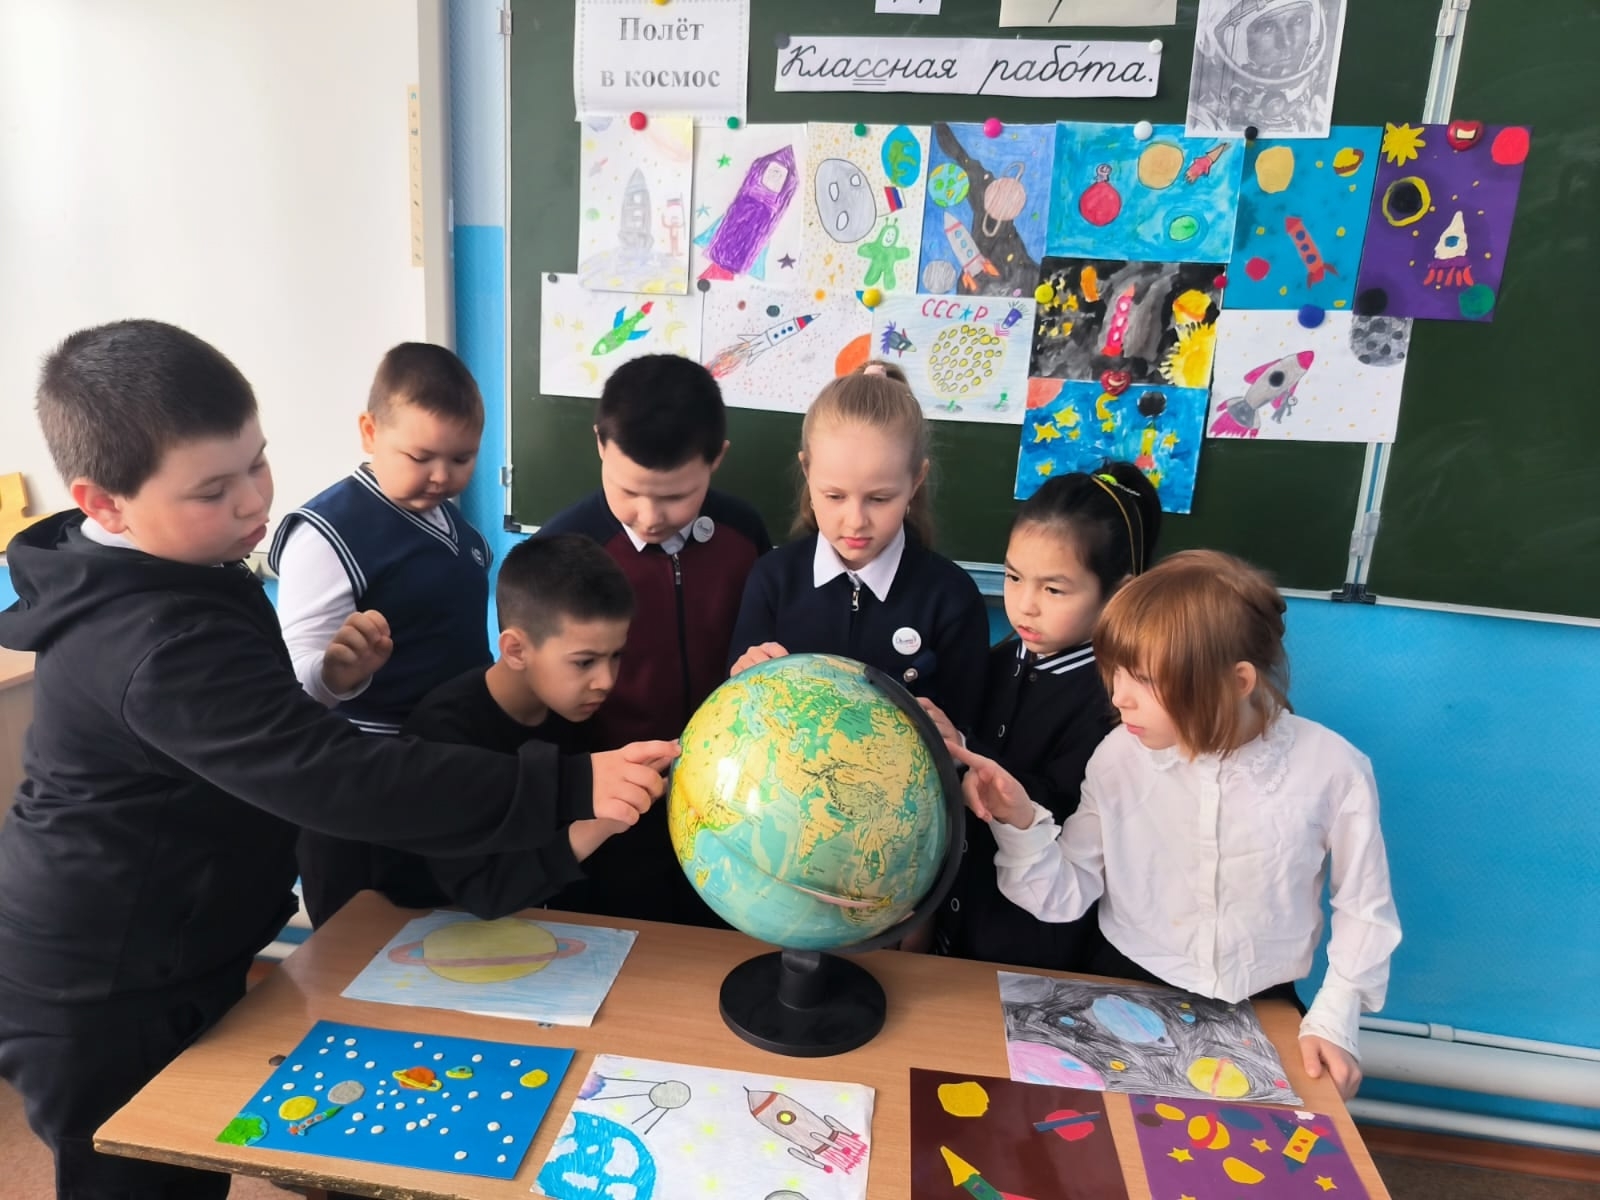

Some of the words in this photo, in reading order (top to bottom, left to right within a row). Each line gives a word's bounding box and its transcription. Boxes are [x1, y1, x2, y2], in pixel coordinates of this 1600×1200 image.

[619, 17, 704, 41] Полёт
[781, 45, 958, 85] Классная
[600, 70, 615, 87] в
[624, 70, 720, 87] космос
